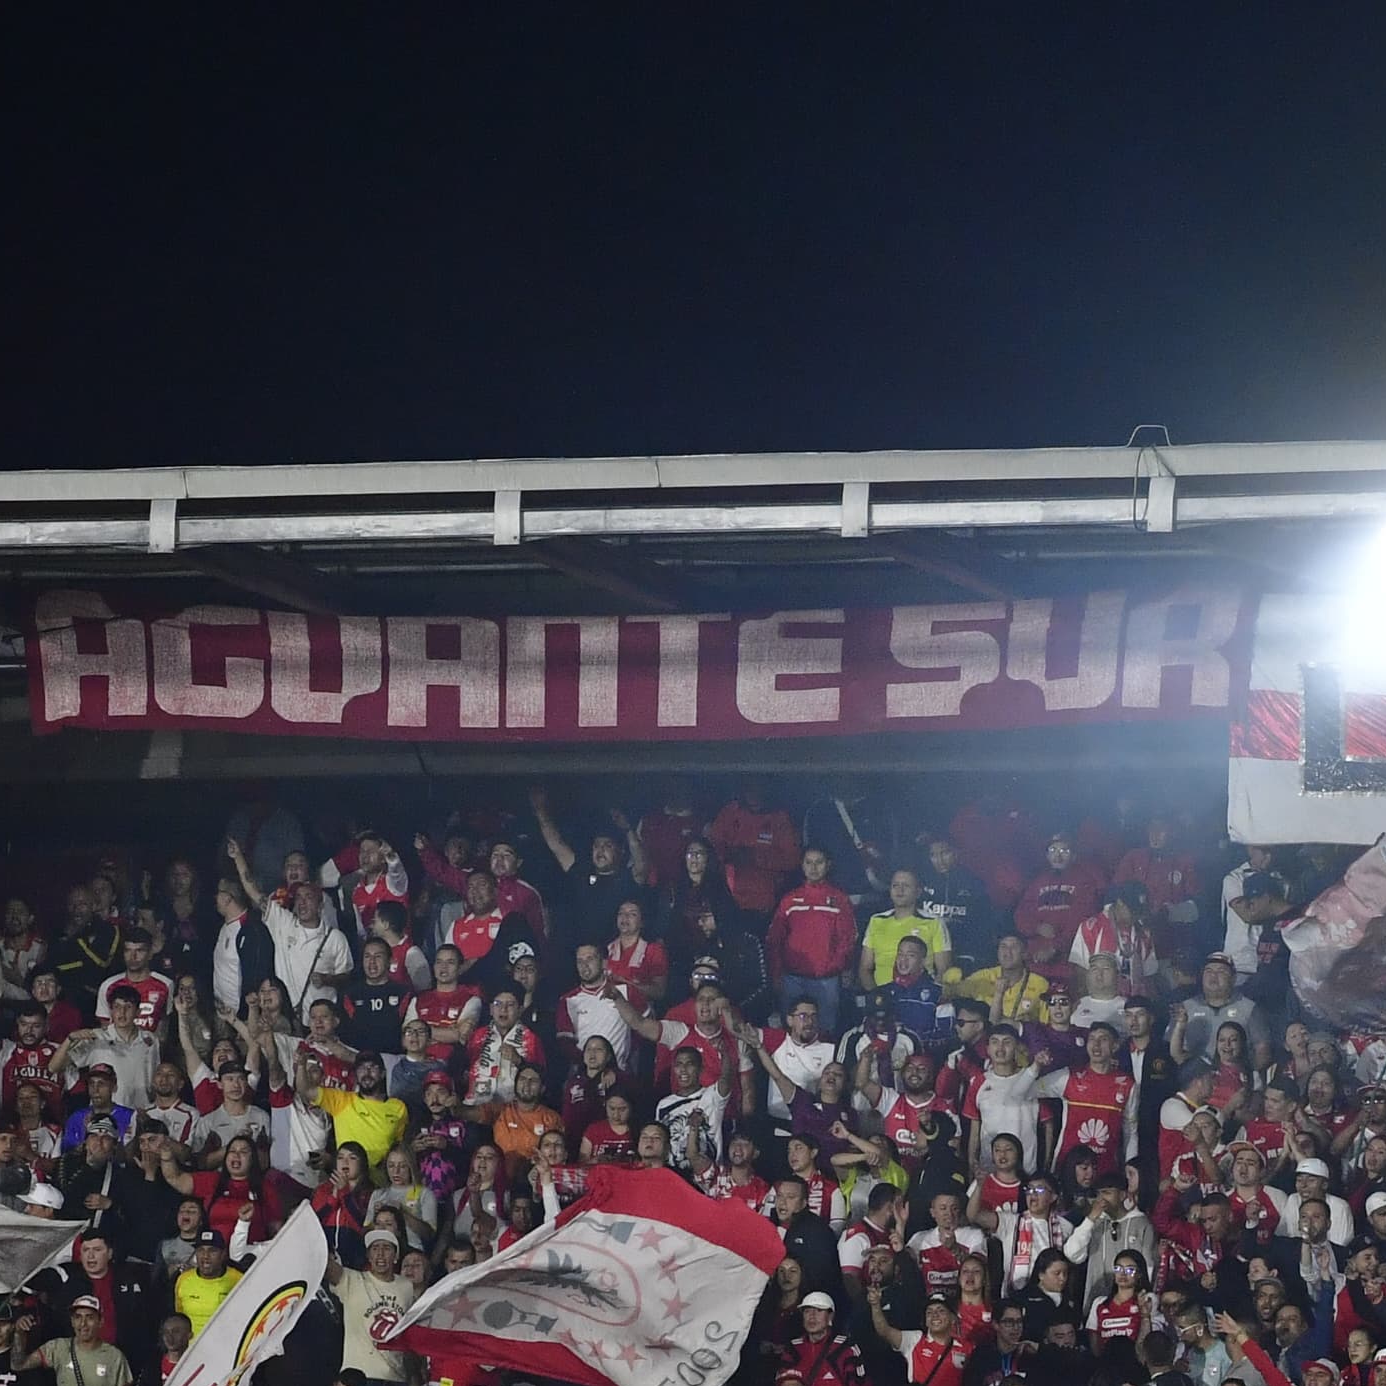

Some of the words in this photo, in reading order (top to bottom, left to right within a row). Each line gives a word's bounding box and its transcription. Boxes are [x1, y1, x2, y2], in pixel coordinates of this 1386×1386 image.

[35, 589, 846, 729] AGUANTE
[885, 588, 1242, 718] SUR
[371, 998, 384, 1011] 10
